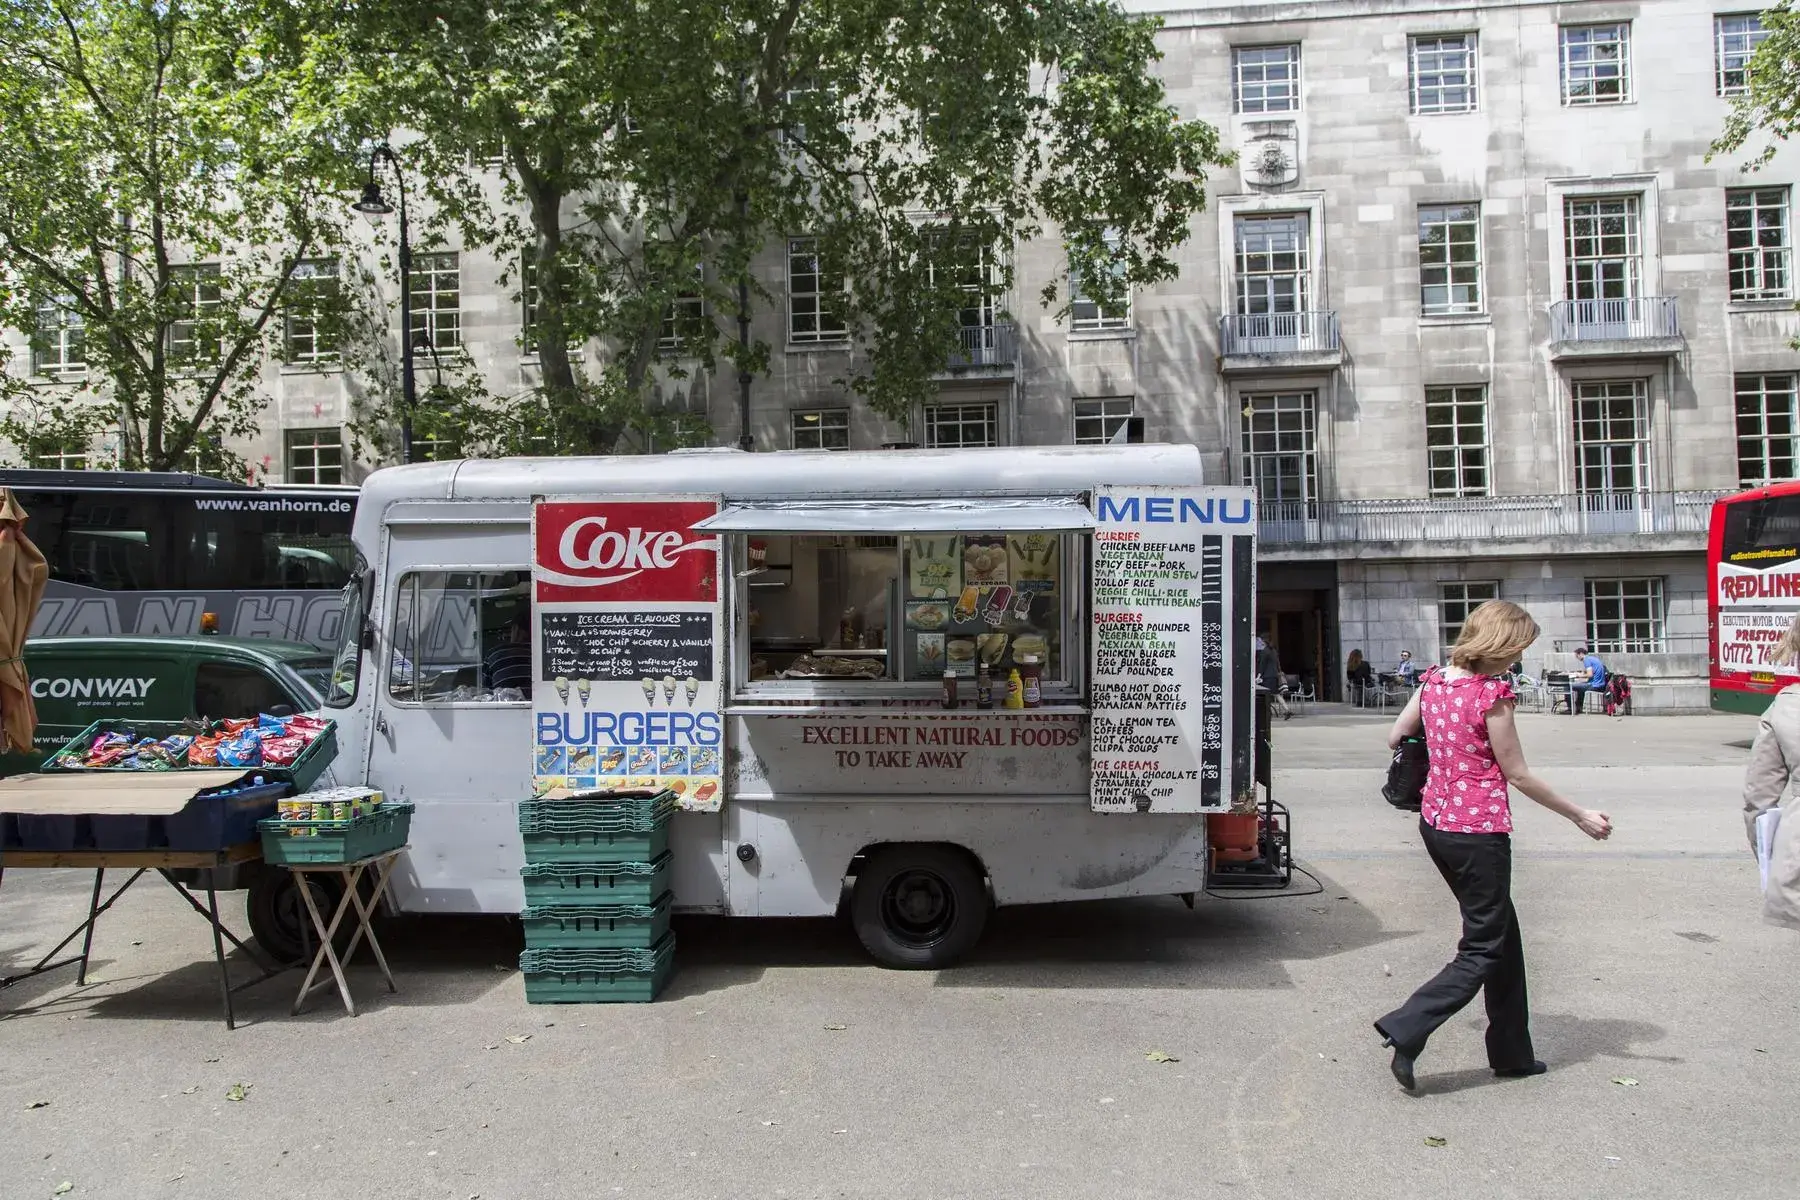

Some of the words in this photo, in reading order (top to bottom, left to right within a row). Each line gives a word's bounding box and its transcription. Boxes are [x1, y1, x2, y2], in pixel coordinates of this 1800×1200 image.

[195, 498, 351, 513] www.vanhorn.de
[1099, 496, 1251, 523] MENU
[1096, 532, 1140, 541] CURRIES
[559, 516, 683, 570] Coke
[1100, 552, 1164, 560] VEGETARIAN
[1095, 560, 1123, 569] SPICY
[1125, 561, 1150, 569] BEEF
[1159, 561, 1185, 570] PORK
[1123, 570, 1171, 579] PLANTAIN
[1172, 571, 1199, 580] STEW
[1094, 579, 1129, 587] JOLLOF
[1095, 588, 1128, 596] VEGGIE
[1132, 589, 1161, 597] CHILLI
[1096, 597, 1130, 606] KUTTU
[1136, 598, 1170, 607] KUTTU
[1171, 599, 1201, 607] BEANS
[577, 615, 592, 624] ICE
[595, 615, 629, 623] CREAM
[634, 614, 680, 623] FLAVOURS
[1094, 613, 1142, 624] BURGERS
[1722, 616, 1751, 626] EXECUTIVE
[1752, 616, 1773, 626] MOTOR
[1100, 624, 1144, 632] QUARTER
[1147, 624, 1190, 632] POUNDER
[593, 629, 652, 637] STRAWBERRY
[1099, 632, 1157, 640] VEGEBURGER
[639, 639, 670, 647] CHERRY
[673, 639, 679, 647] &
[680, 638, 712, 646] VANILLA
[1099, 641, 1145, 649] MEXICAN
[1150, 641, 1175, 649] BEAN
[1722, 642, 1753, 664] 01772
[1120, 659, 1157, 667] BURGER
[1097, 667, 1122, 675] HALF
[1127, 668, 1174, 676] POUNDER
[30, 678, 156, 698] CONWAY
[1092, 702, 1143, 710] JAMAICAN
[1148, 702, 1186, 710] PATTIES
[1120, 718, 1153, 726] LEMON
[1157, 718, 1175, 726] TEA
[537, 712, 721, 745] BURGERS
[1094, 727, 1133, 735] COFFEES
[802, 726, 911, 745] EXCELLENT
[915, 727, 1006, 746] NATURAL
[1010, 728, 1080, 746] FOODS
[1094, 736, 1116, 744] HOT
[1119, 736, 1178, 744] CHOCOLATE
[1093, 744, 1124, 752] CUPPA
[835, 751, 860, 768] TO
[868, 751, 911, 770] TAKE
[916, 751, 968, 769] AWAY
[1094, 761, 1108, 769] ICE
[1114, 761, 1159, 770] CREAMS
[1143, 771, 1197, 779] CHOCOLATE
[1094, 780, 1152, 788] STRAWBERRY
